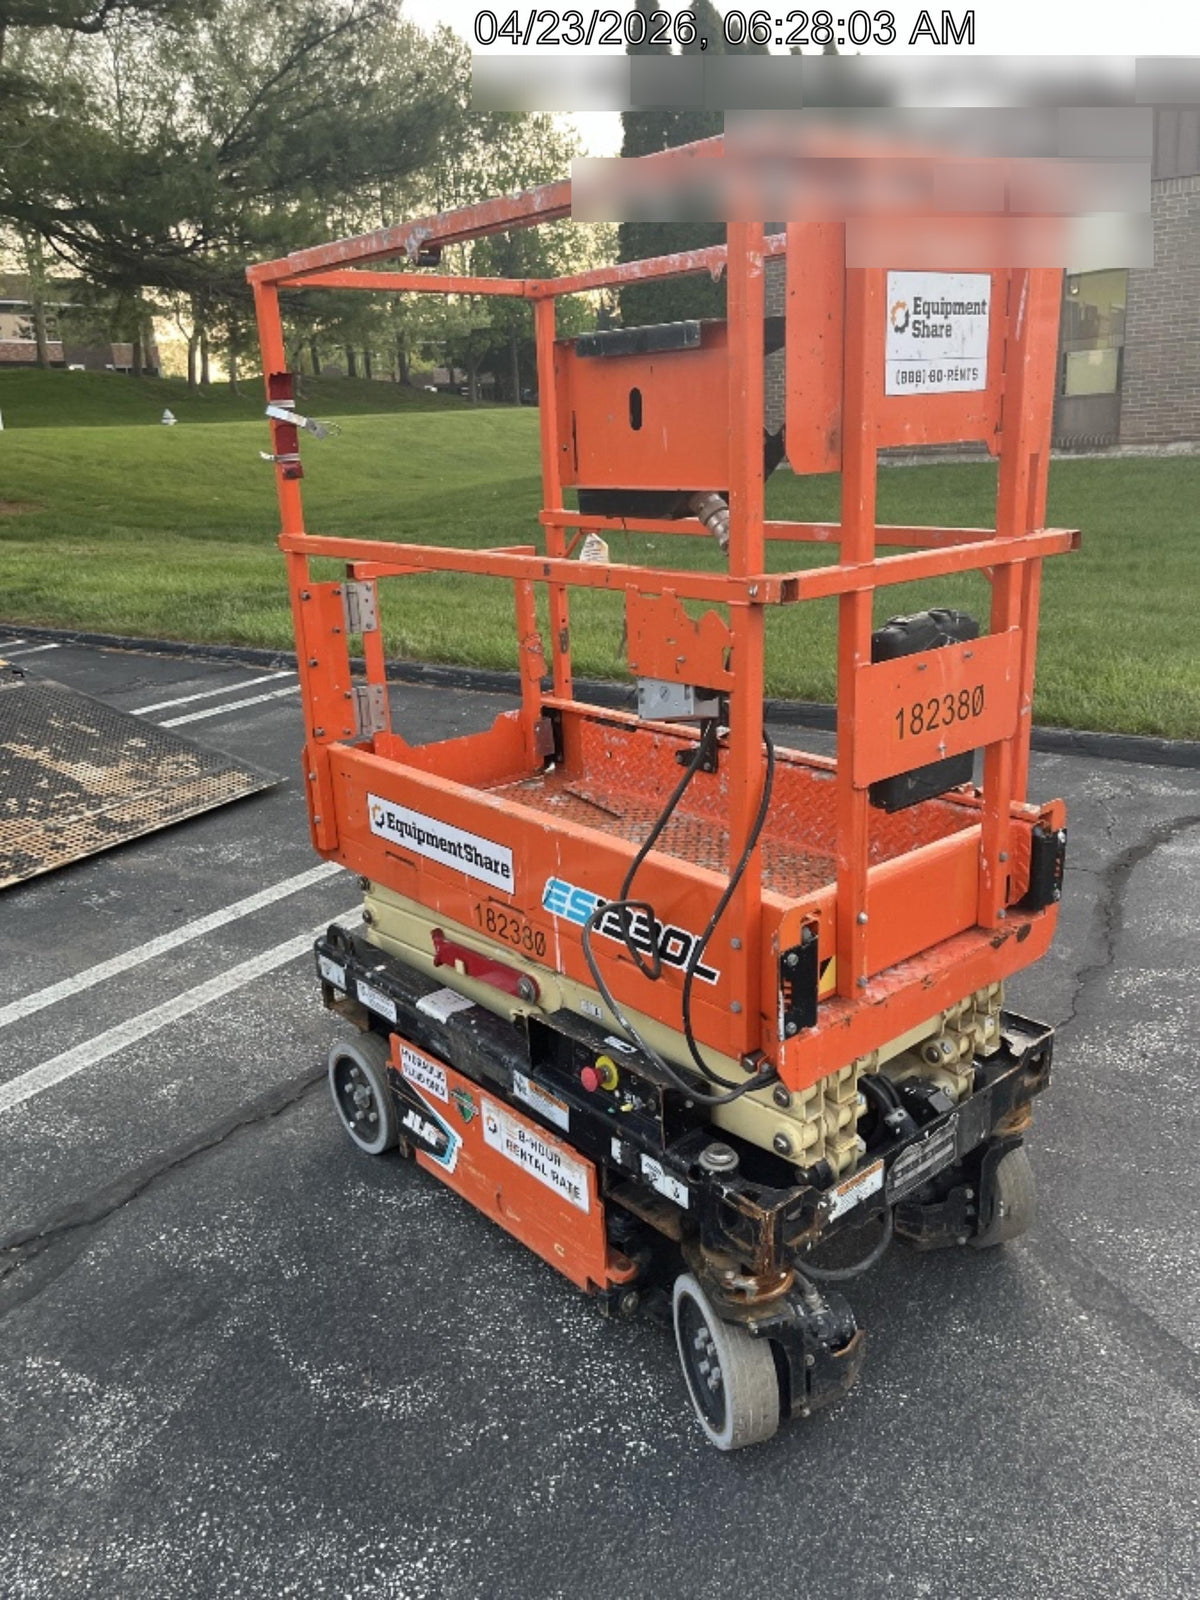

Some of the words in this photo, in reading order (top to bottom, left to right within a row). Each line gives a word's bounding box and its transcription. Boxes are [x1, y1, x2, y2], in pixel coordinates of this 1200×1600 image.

[912, 297, 988, 319] Equipment
[912, 320, 952, 339] Share
[895, 684, 985, 740] 182380
[386, 812, 511, 879] EquipmentShare
[474, 903, 547, 957] 182380
[506, 1138, 547, 1177] RENTAL
[550, 1168, 582, 1201] RATE
